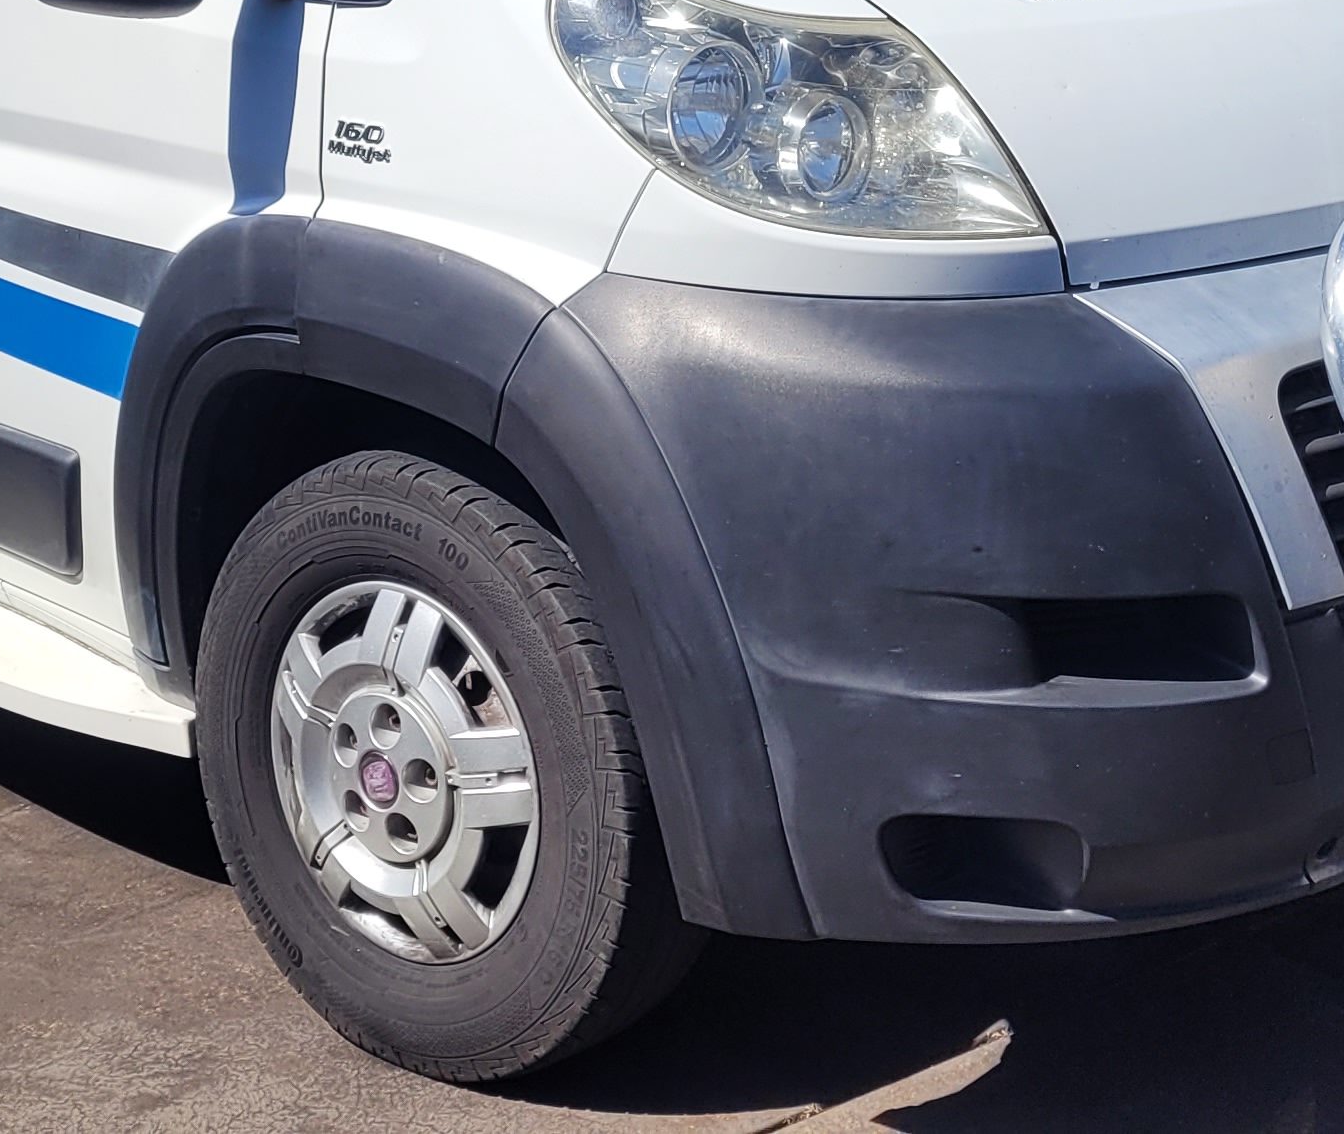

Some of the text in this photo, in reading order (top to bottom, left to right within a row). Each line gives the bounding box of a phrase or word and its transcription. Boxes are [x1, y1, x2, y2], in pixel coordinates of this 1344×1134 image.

[335, 120, 385, 145] 160
[276, 505, 470, 572] ContiVanContact 100
